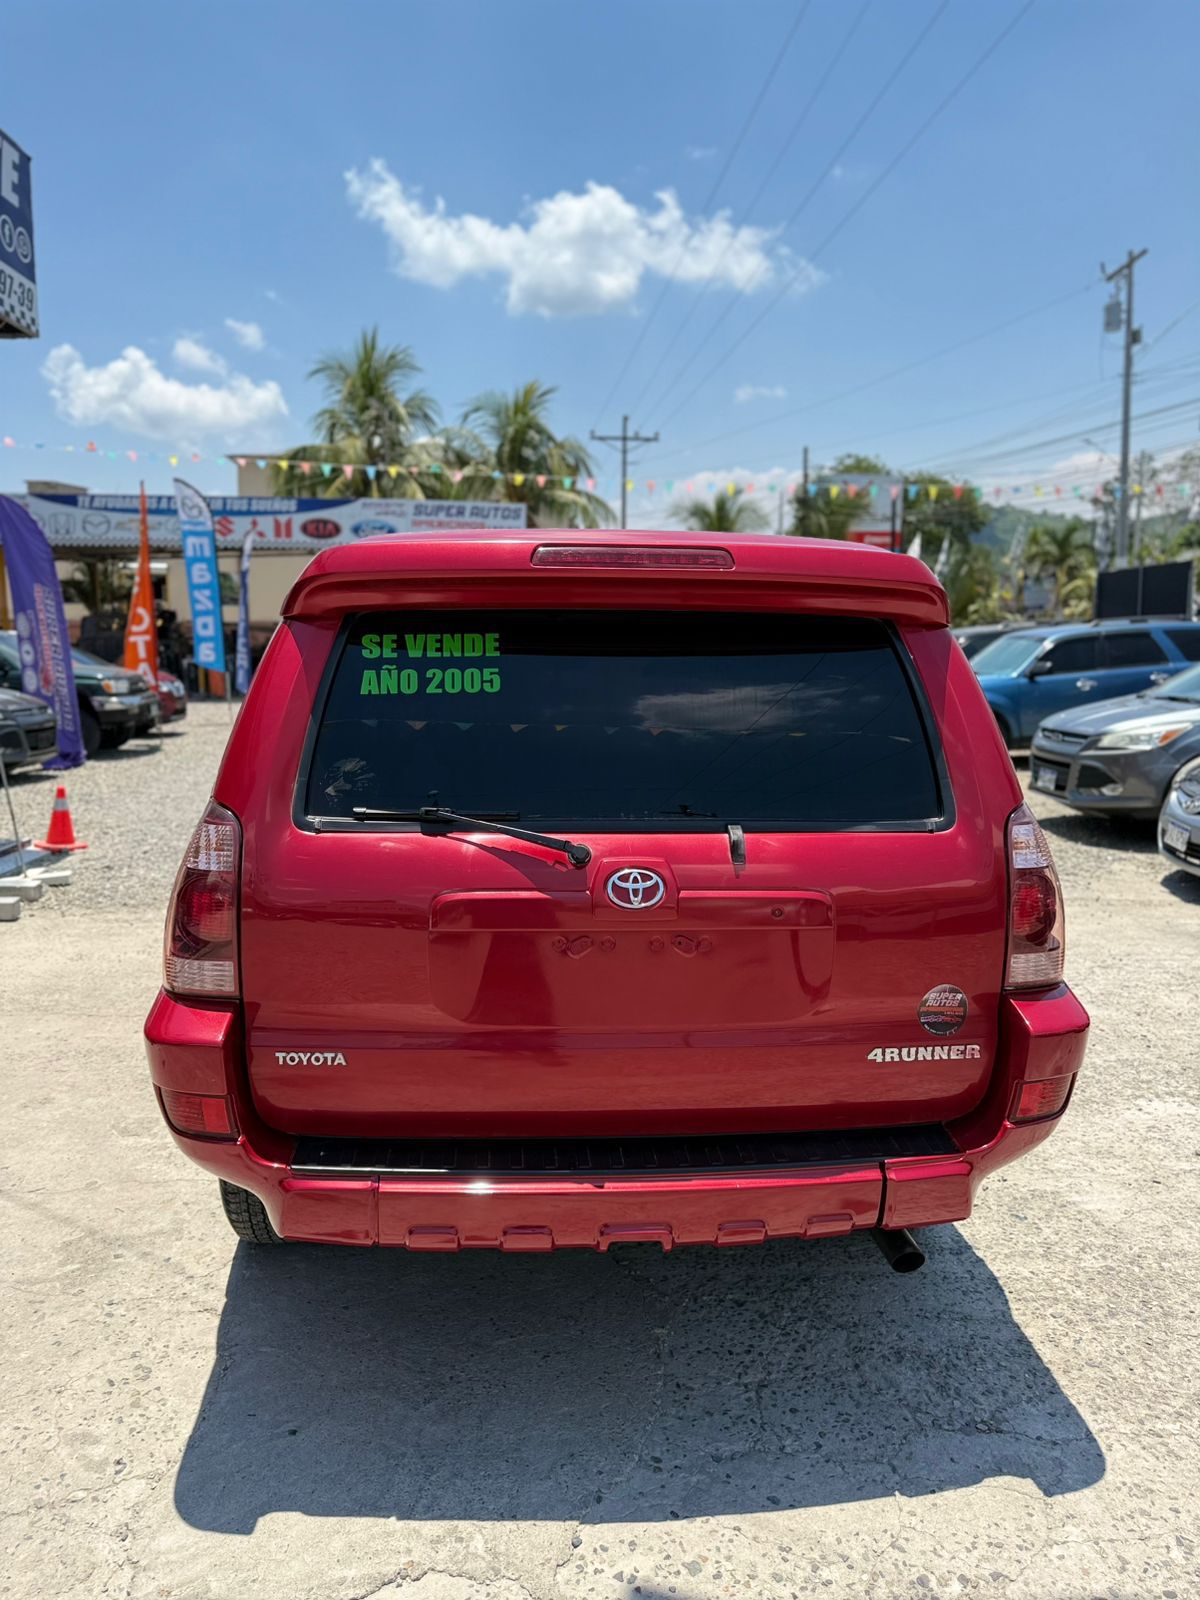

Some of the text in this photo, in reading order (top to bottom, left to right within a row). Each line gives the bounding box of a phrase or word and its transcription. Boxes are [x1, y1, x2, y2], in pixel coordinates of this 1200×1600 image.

[413, 503, 466, 517] SUPER
[469, 505, 522, 520] AUTOS
[305, 521, 338, 536] KIA
[361, 632, 501, 659] SE VENDE
[360, 664, 501, 695] AÑO 2005
[925, 999, 960, 1007] AUTOS
[929, 991, 962, 1000] SUPER
[274, 1051, 347, 1066] TOYOTA
[867, 1044, 981, 1062] 4RUNNER
